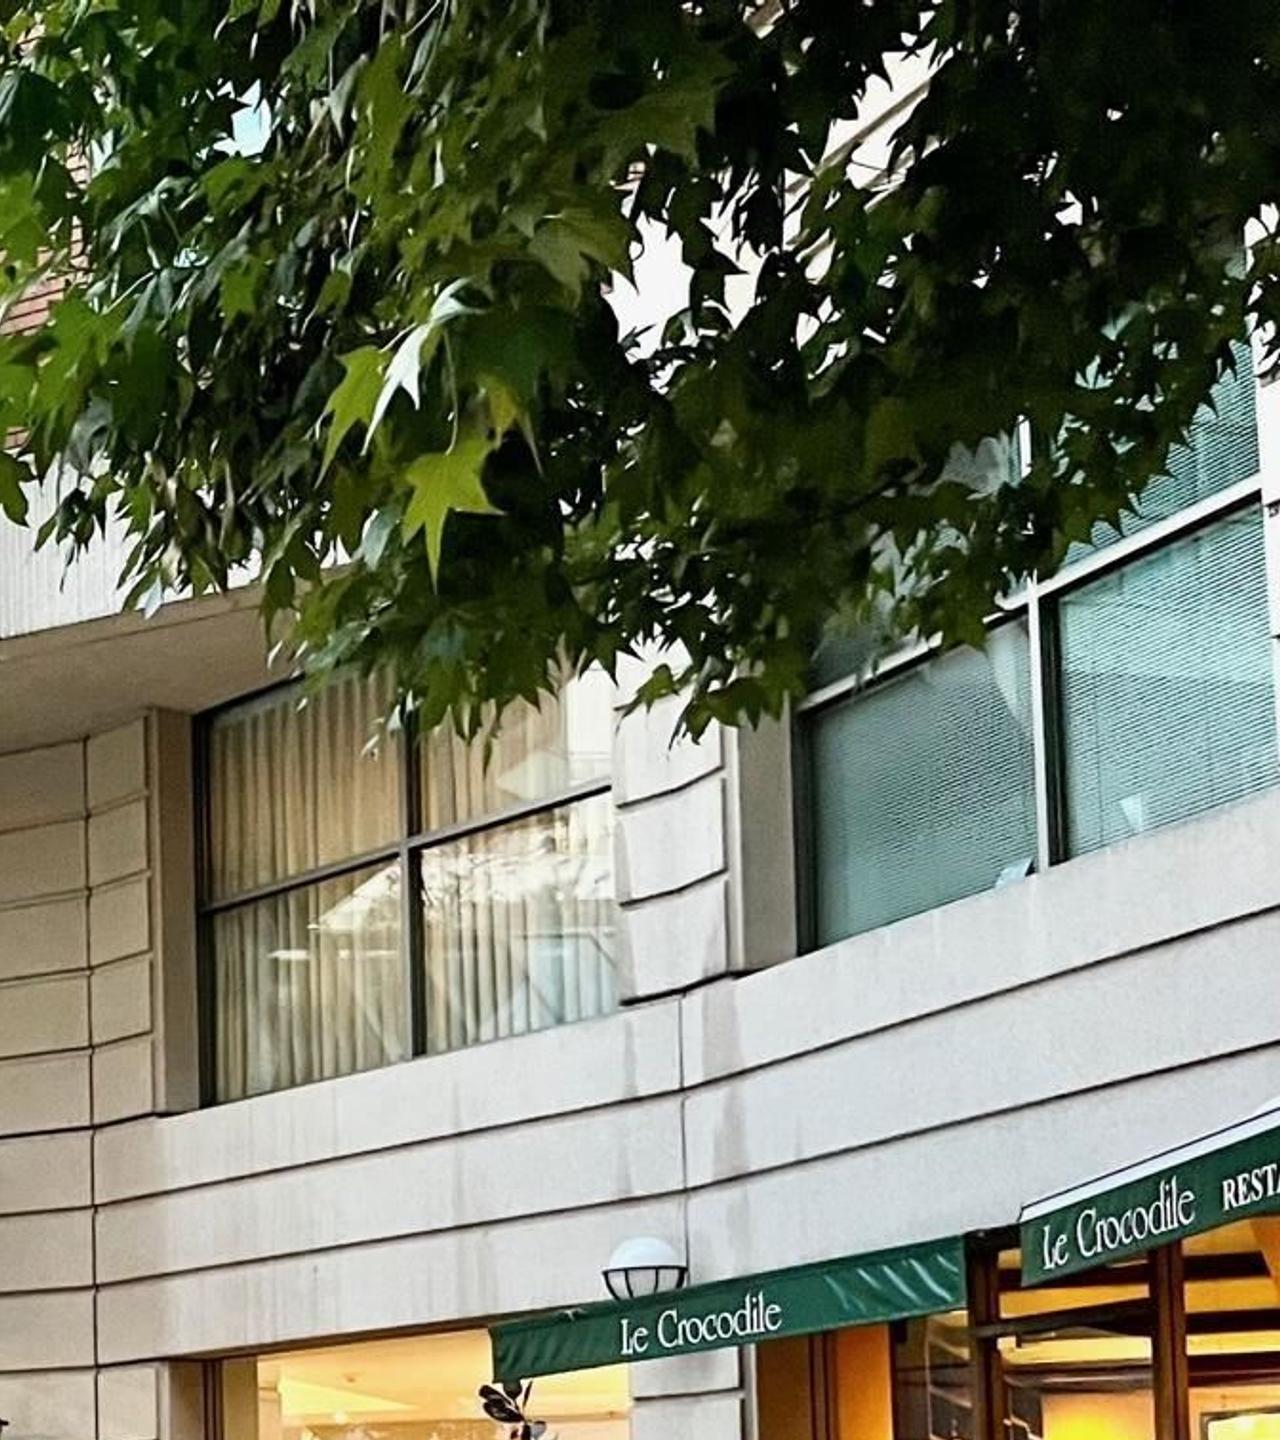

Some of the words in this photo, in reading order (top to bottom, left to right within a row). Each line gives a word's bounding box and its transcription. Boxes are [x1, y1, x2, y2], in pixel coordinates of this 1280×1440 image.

[1043, 1225, 1069, 1270] Le
[1077, 1175, 1196, 1258] Crocodile
[1222, 1163, 1280, 1211] REST
[621, 1318, 649, 1355] Le
[657, 1290, 782, 1348] Crocodile
